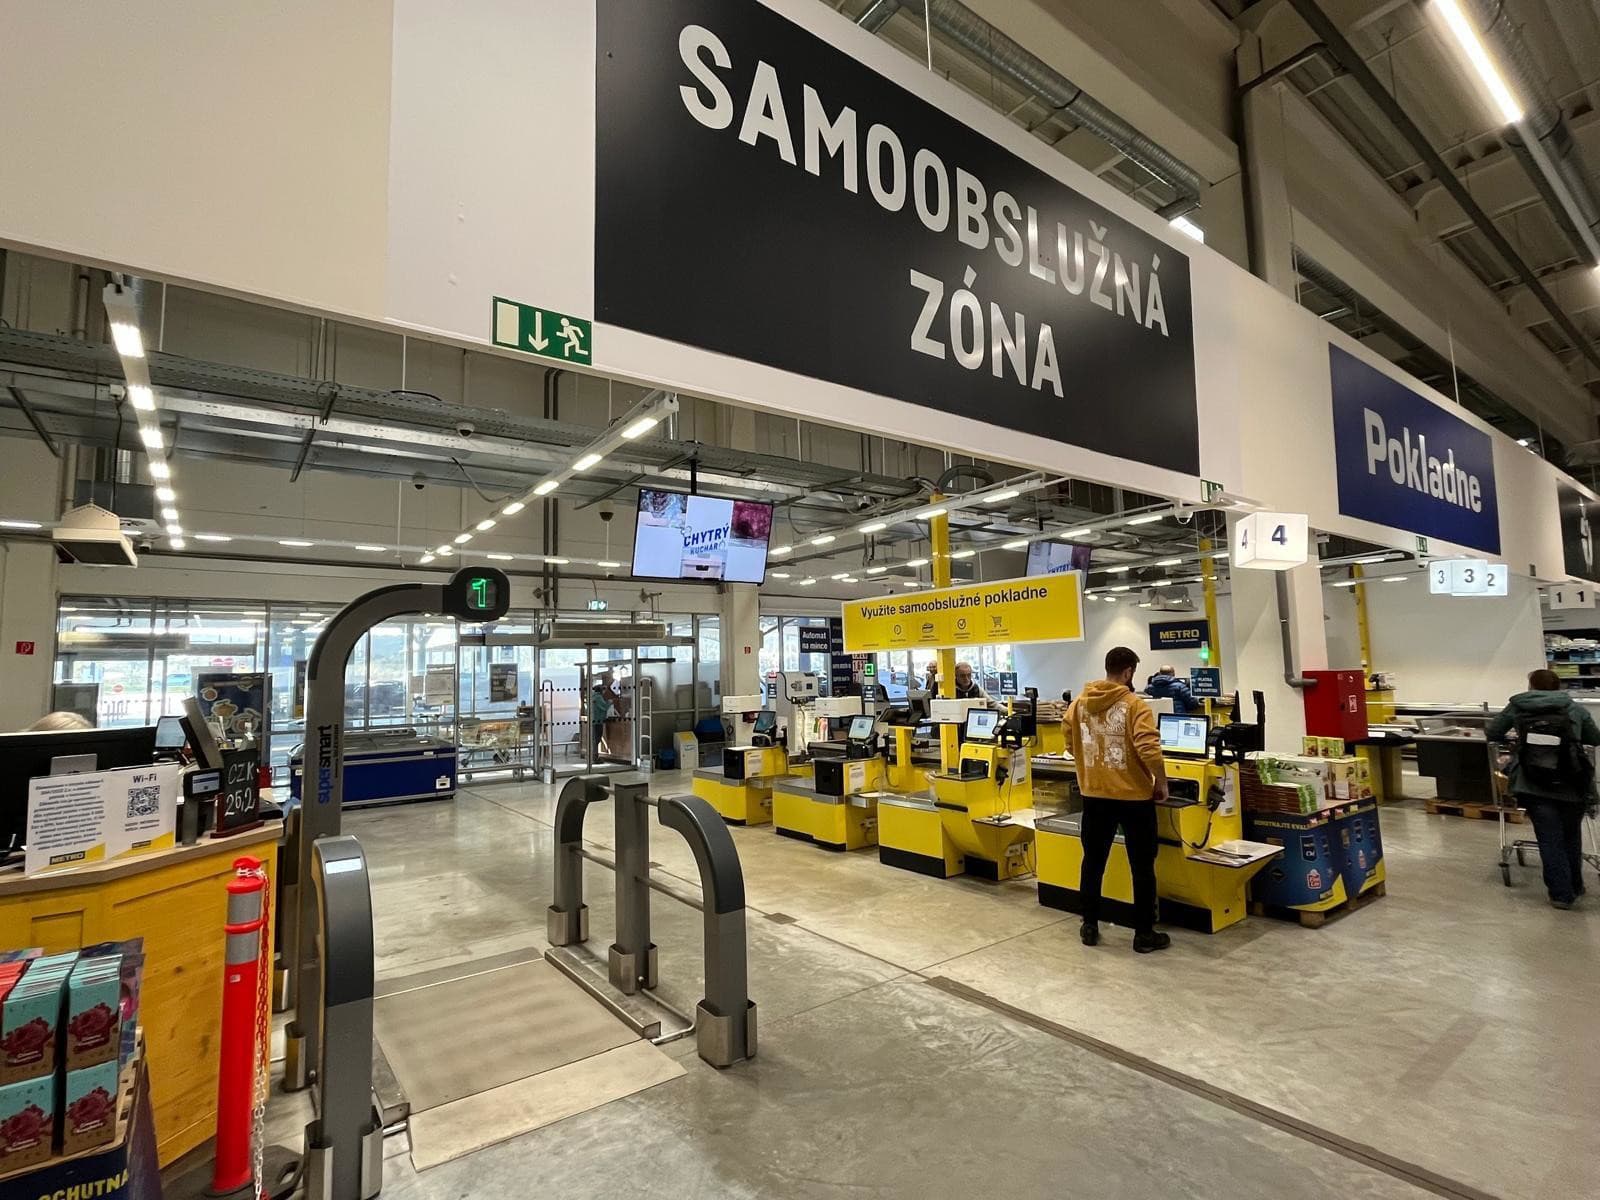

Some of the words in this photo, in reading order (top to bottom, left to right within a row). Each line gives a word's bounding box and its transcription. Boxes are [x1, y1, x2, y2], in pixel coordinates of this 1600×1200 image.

[679, 24, 1169, 337] SAMOOBSLUŽNÁ
[910, 265, 1064, 399] ZÓNA
[1364, 407, 1482, 513] Pokladne
[684, 523, 730, 547] CHYTRÝ
[1271, 525, 1288, 545] 4
[1438, 570, 1445, 584] 3
[1464, 568, 1475, 583] 3
[1487, 573, 1496, 587] 2
[471, 578, 487, 608] 1
[899, 594, 981, 615] samoobslužné
[984, 586, 1048, 608] pokladne
[1556, 591, 1563, 603] 1
[1576, 590, 1585, 603] 1
[802, 631, 827, 640] Automat
[1159, 629, 1200, 640] METRO
[810, 641, 828, 650] mince
[318, 724, 334, 804] supersmart
[133, 773, 157, 784] Wi-Fi
[228, 761, 255, 785] CZK
